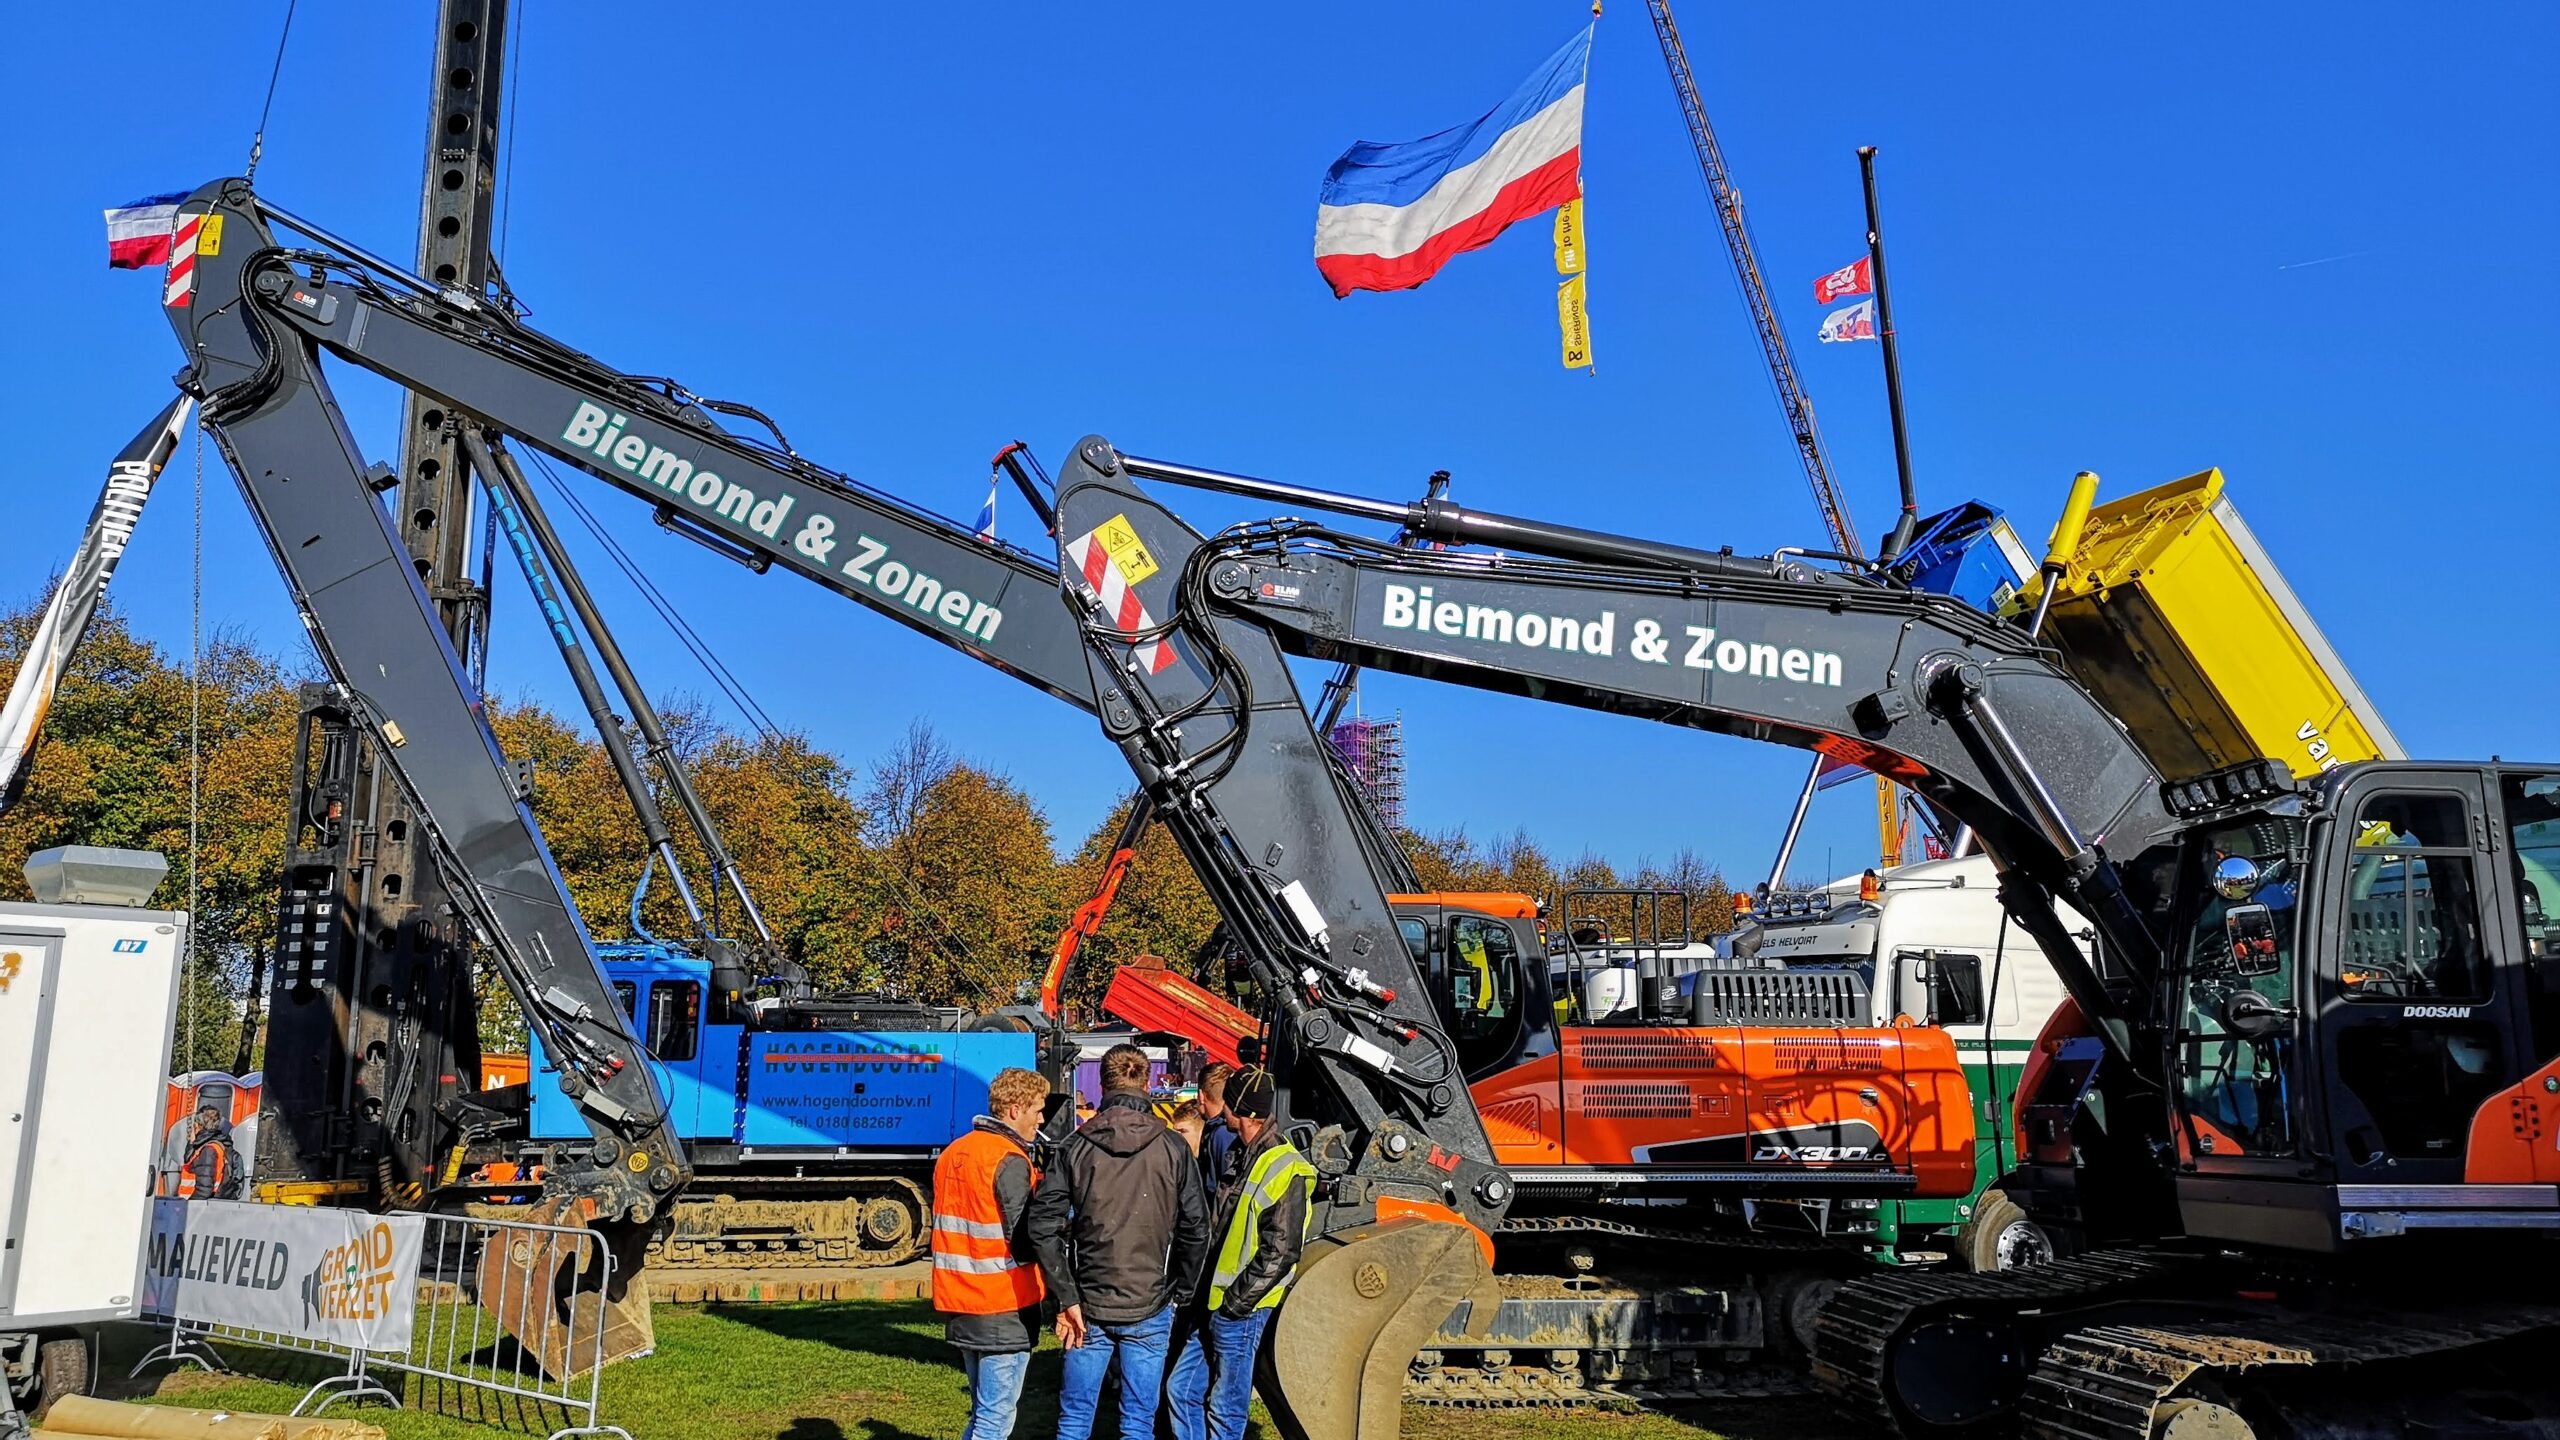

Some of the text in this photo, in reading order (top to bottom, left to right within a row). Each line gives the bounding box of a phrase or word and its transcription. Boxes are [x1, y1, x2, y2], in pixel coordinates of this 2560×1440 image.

[562, 400, 1004, 642] Biemond & Zonen
[1383, 584, 1843, 687] Biemond & Zonen
[1778, 935, 1819, 947] HELVOIRT
[2403, 1006, 2471, 1018] DOOSAN
[765, 1042, 939, 1073] HOGENDOORN
[762, 1094, 932, 1110] www.hogendoornbv.nl
[788, 1115, 902, 1129] Tel. 0180 682687
[145, 1232, 289, 1291] MALIEVELD
[321, 1221, 393, 1285] GROND
[318, 1271, 395, 1321] VERZET
